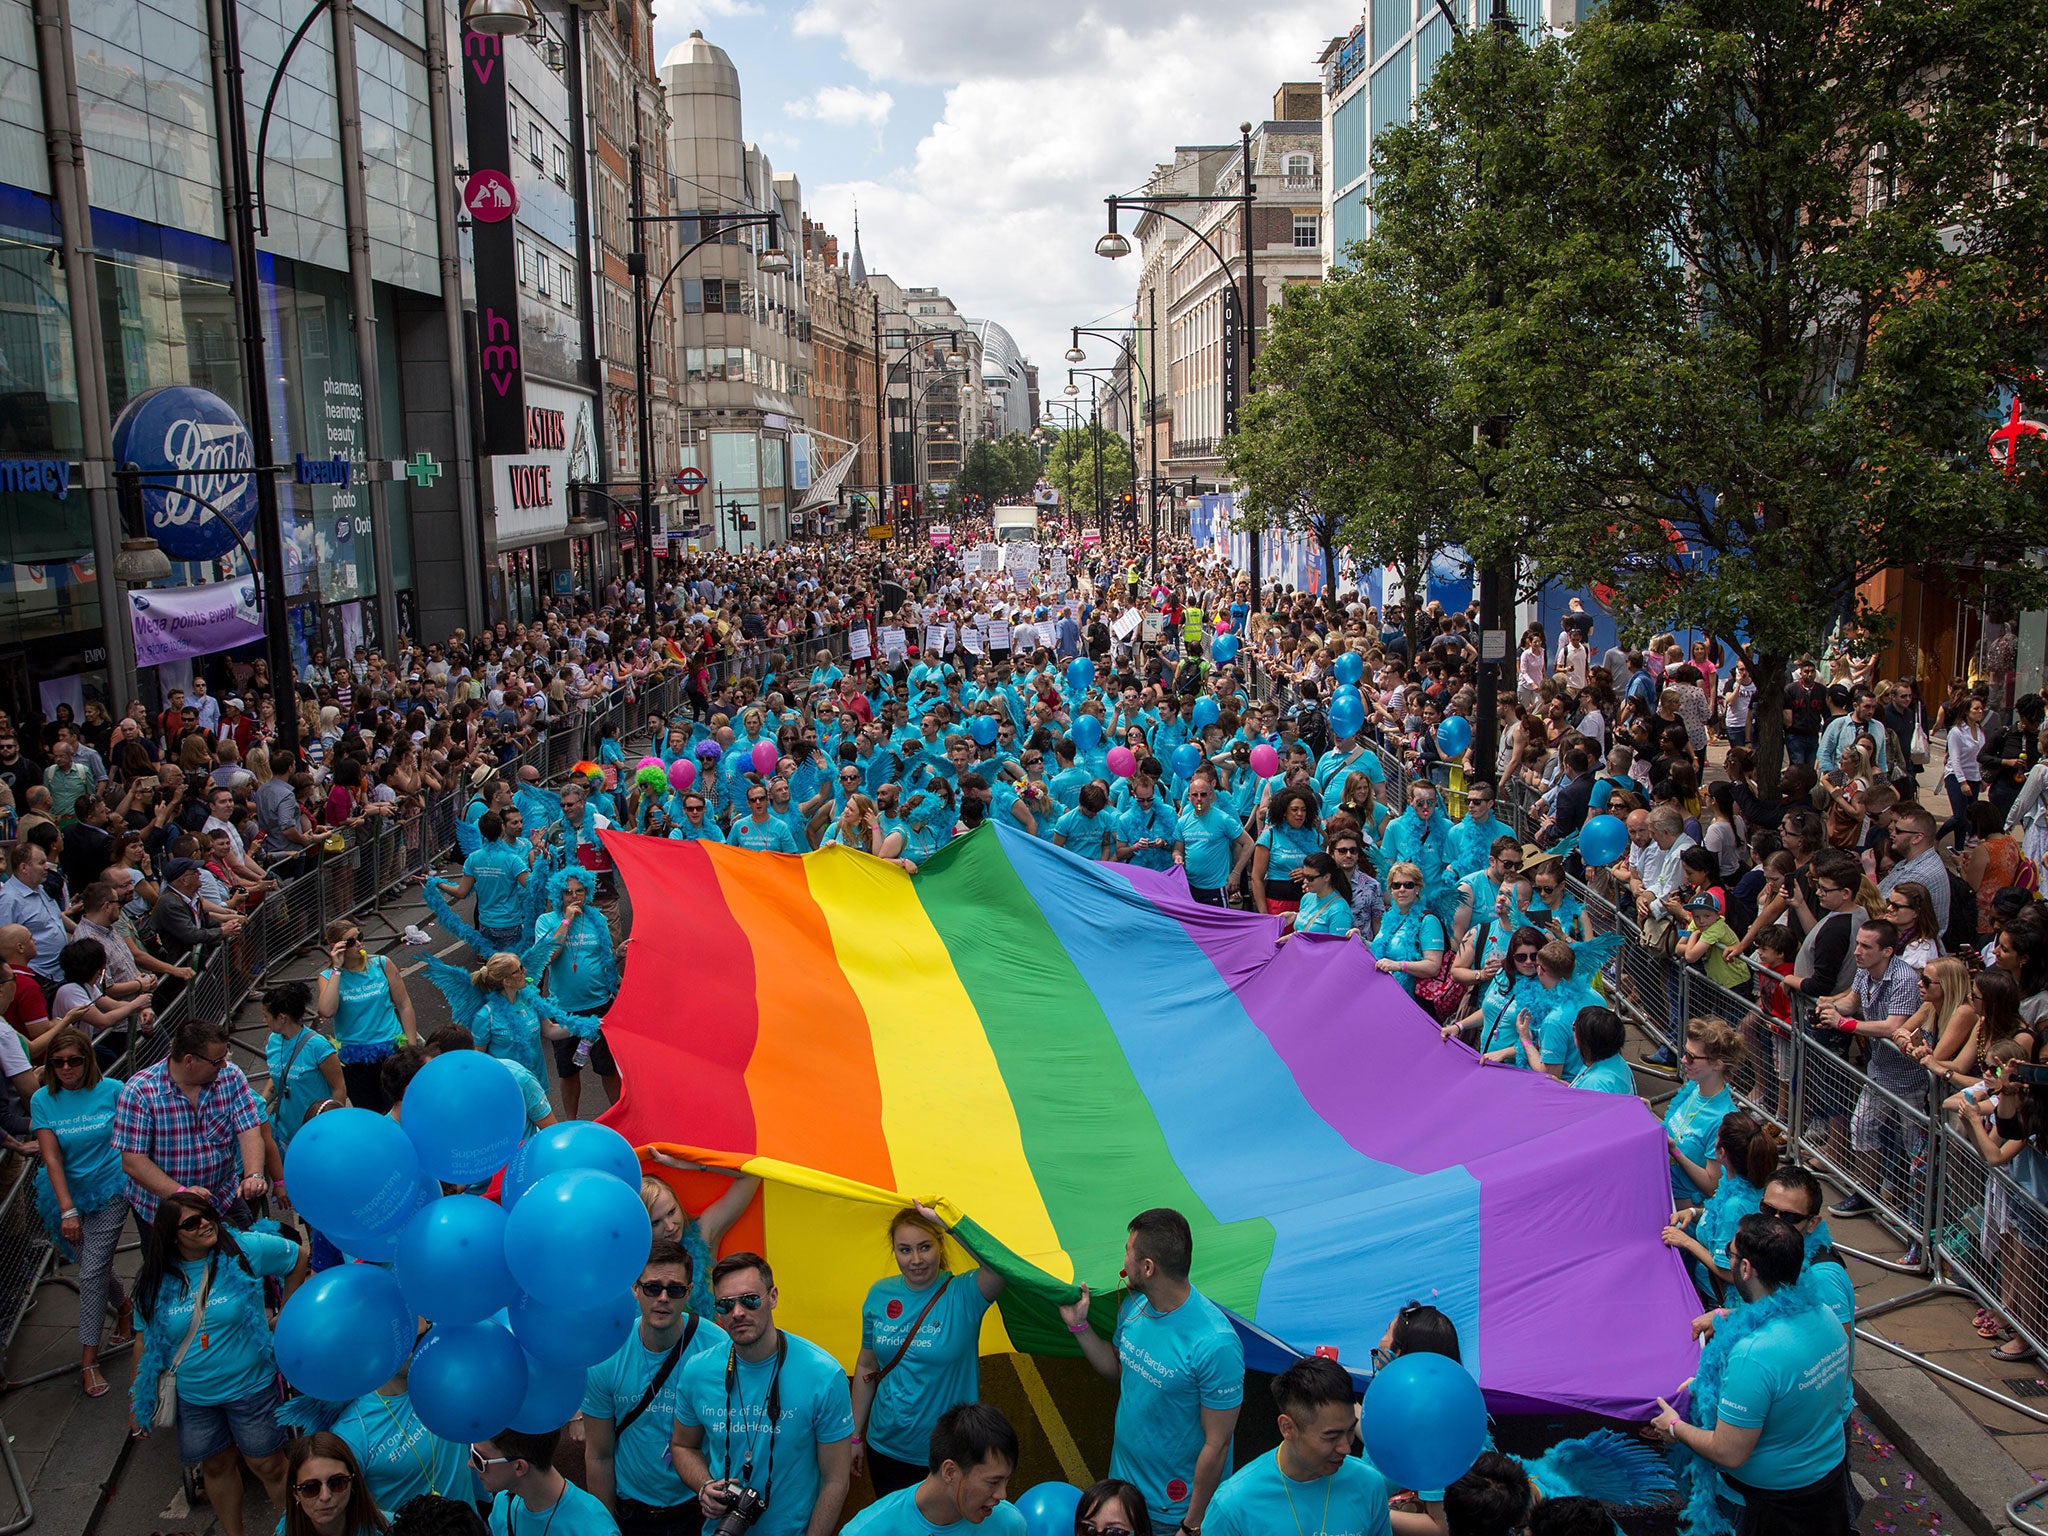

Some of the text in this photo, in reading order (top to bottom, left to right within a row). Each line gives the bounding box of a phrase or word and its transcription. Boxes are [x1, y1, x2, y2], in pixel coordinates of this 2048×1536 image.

[463, 30, 501, 86] mv
[482, 307, 518, 397] hmv
[1225, 291, 1233, 402] FOREVER
[325, 401, 364, 424] hearingc
[327, 423, 355, 445] beauty
[526, 405, 567, 451] ASTERS
[0, 459, 70, 501] macy
[154, 419, 250, 528] Boots
[295, 453, 350, 490] beauty
[332, 490, 357, 512] photo
[508, 465, 553, 510] VOICE
[354, 516, 372, 537] Opti
[135, 612, 168, 637] Mega
[170, 612, 207, 634] points
[209, 603, 236, 623] event
[84, 648, 106, 664] EMPO
[148, 641, 170, 658] store
[169, 636, 193, 654] today
[55, 1121, 106, 1135] #PrideHeroes
[58, 1118, 71, 1126] one
[73, 1115, 80, 1123] of
[351, 1168, 402, 1218] Supporting
[168, 1295, 228, 1316] #Prideeroes
[876, 1335, 932, 1348] #Prideeroes
[1124, 1338, 1136, 1353] one
[1135, 1347, 1144, 1359] of
[1143, 1350, 1179, 1379] Barclays'
[702, 1405, 715, 1417] I'm
[738, 1404, 750, 1418] of
[712, 1420, 781, 1435] #PideHeroes
[388, 1423, 428, 1463] #PrideH
